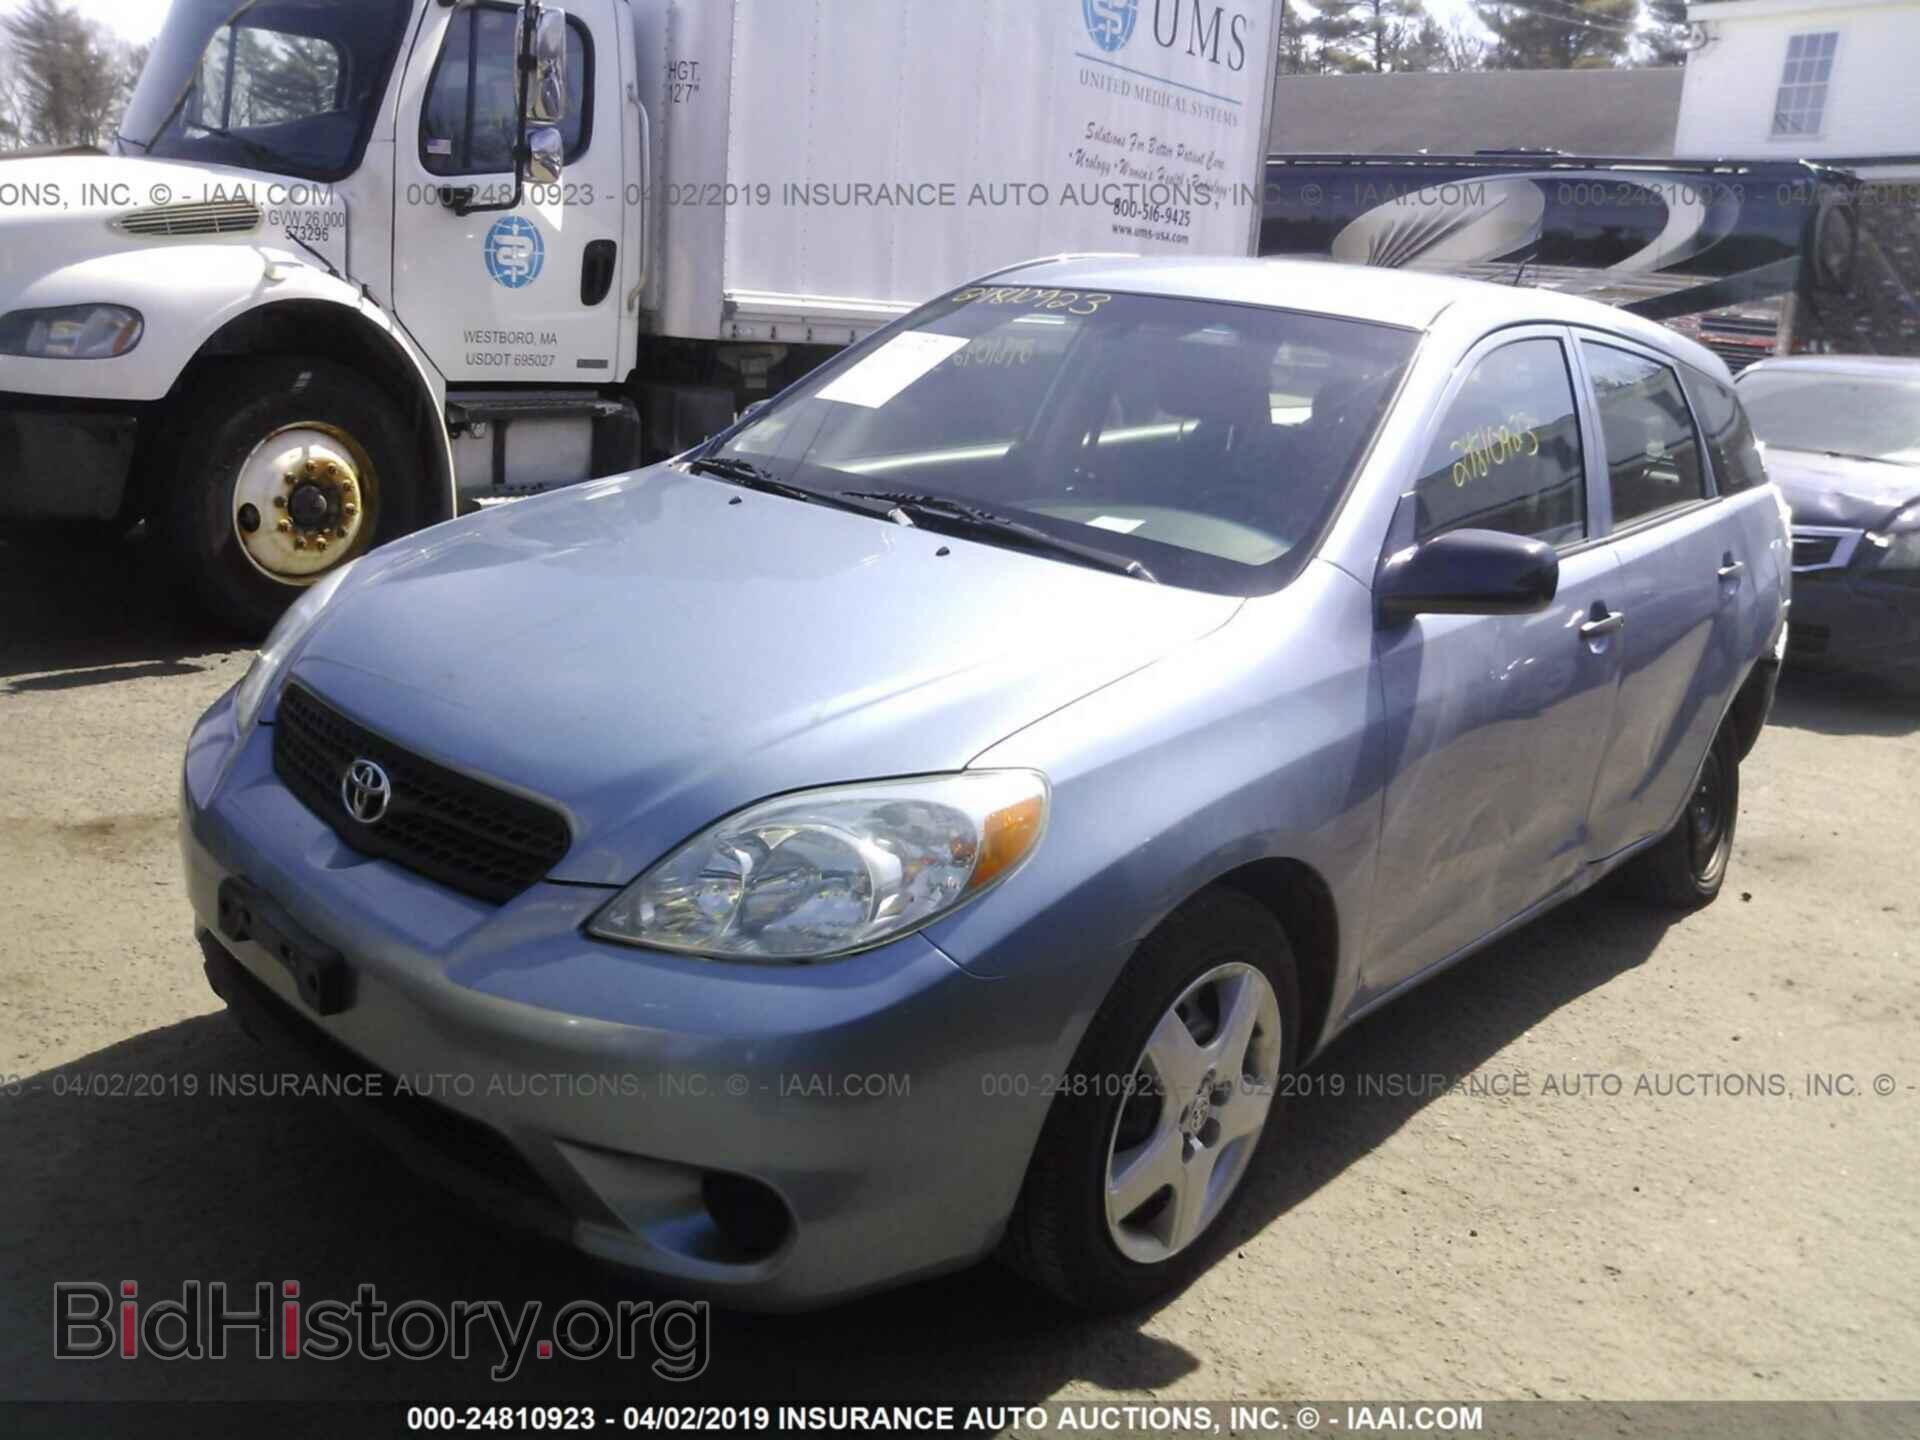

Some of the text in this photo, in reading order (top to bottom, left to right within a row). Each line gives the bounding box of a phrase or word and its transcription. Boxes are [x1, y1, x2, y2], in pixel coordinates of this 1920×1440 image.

[1153, 0, 1248, 72] UMS
[1079, 67, 1239, 128] UNITED MEDICAL SYSTEMS
[268, 209, 302, 226] GVW
[1112, 197, 1191, 227] 800-516-9425
[285, 225, 329, 242] 573296
[463, 330, 558, 346] WESTBORO, MA
[465, 352, 556, 368] USDOT 695027
